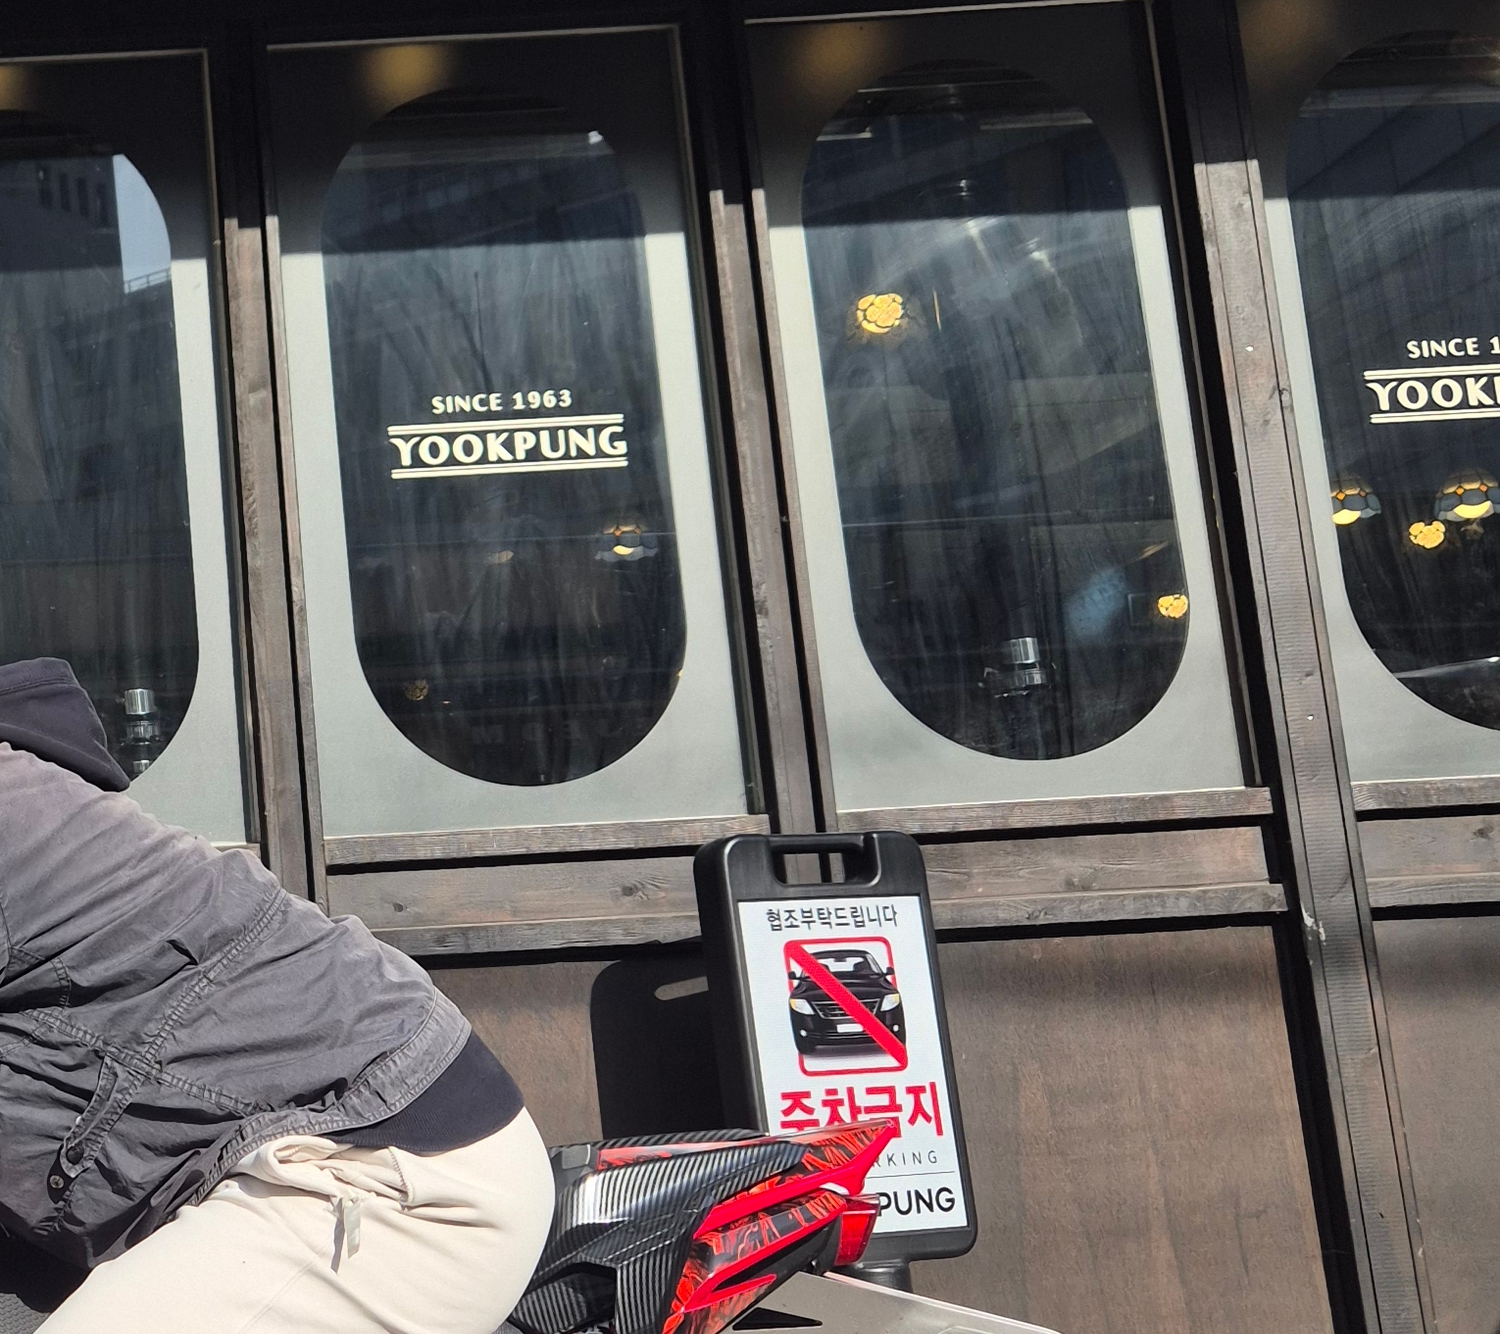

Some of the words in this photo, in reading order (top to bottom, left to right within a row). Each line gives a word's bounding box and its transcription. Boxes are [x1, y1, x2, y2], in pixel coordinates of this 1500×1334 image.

[1406, 336, 1480, 359] SINCE
[430, 393, 503, 415] SINCE
[511, 388, 573, 410] 1963
[1365, 375, 1500, 411] YOOK
[391, 424, 628, 468] YOOKPUNG
[766, 903, 899, 933] 협조부탁드립니다
[780, 1081, 944, 1138] 주차금지
[879, 1186, 955, 1217] PUNG
